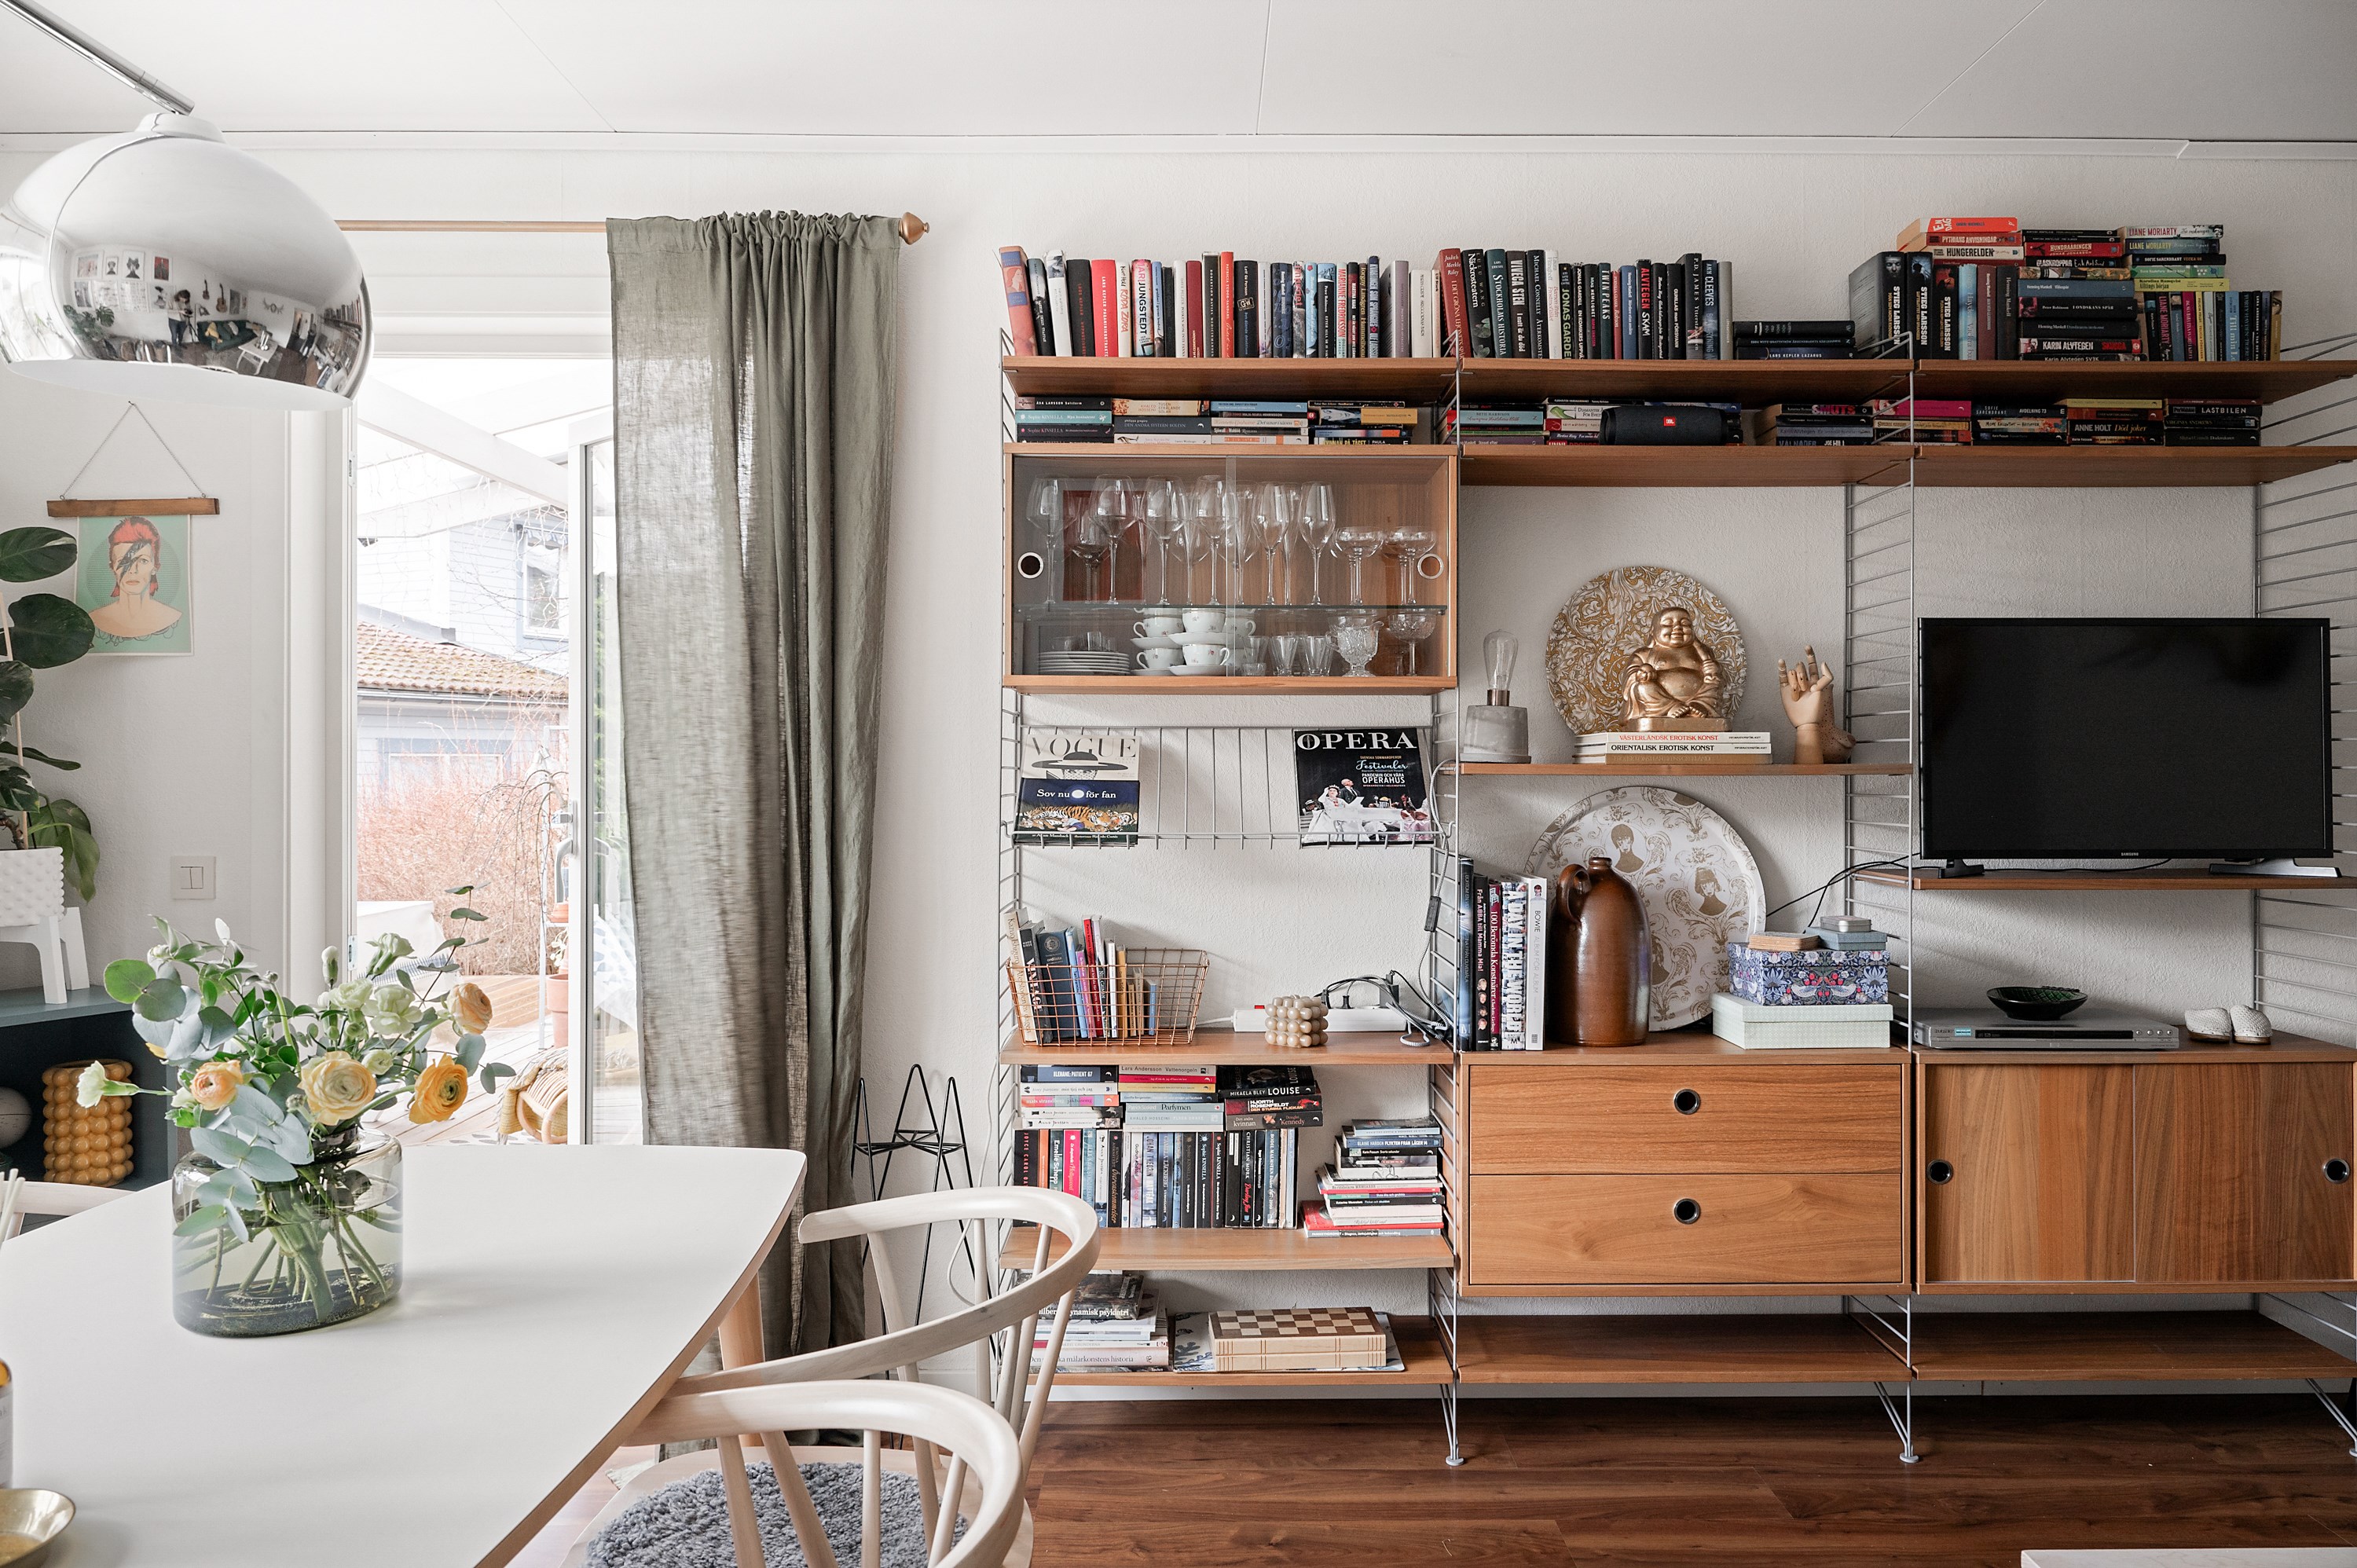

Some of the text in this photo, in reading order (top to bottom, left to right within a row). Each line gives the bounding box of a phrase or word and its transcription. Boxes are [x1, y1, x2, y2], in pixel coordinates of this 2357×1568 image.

[1947, 248, 1995, 257] HUNGERELDEN
[2051, 243, 2091, 251] HUNDRAÅRINGEN
[1468, 253, 1479, 308] Näckrosteatern
[1510, 260, 1525, 306] VIVECA STEN
[1705, 277, 1714, 306] CLEEVES
[1138, 283, 1147, 335] JUNGSTEDT
[1493, 274, 1507, 355] STOCKHOLMS HISTORIA
[1562, 288, 1571, 320] JONAS
[1641, 268, 1651, 335] ALVTEGEN SKAM
[2159, 296, 2169, 344] LIANE MORIARTY
[2229, 315, 2238, 331] Till
[2063, 341, 2094, 350] ALVTEGEN
[1812, 405, 1856, 415] SMUTS
[2130, 424, 2146, 433] joker
[1032, 737, 1136, 758] VOGUE
[1297, 732, 1417, 750] OPERA
[1355, 760, 1409, 771] Festivaler
[1506, 891, 1523, 1032] A DAY IN WORLD
[1026, 958, 1043, 1013] VINTAGE
[1050, 1140, 1062, 1184] Emelie Schepp
[1111, 1169, 1120, 1223] Överenskommelser
[1099, 1308, 1129, 1317] psykiatri
